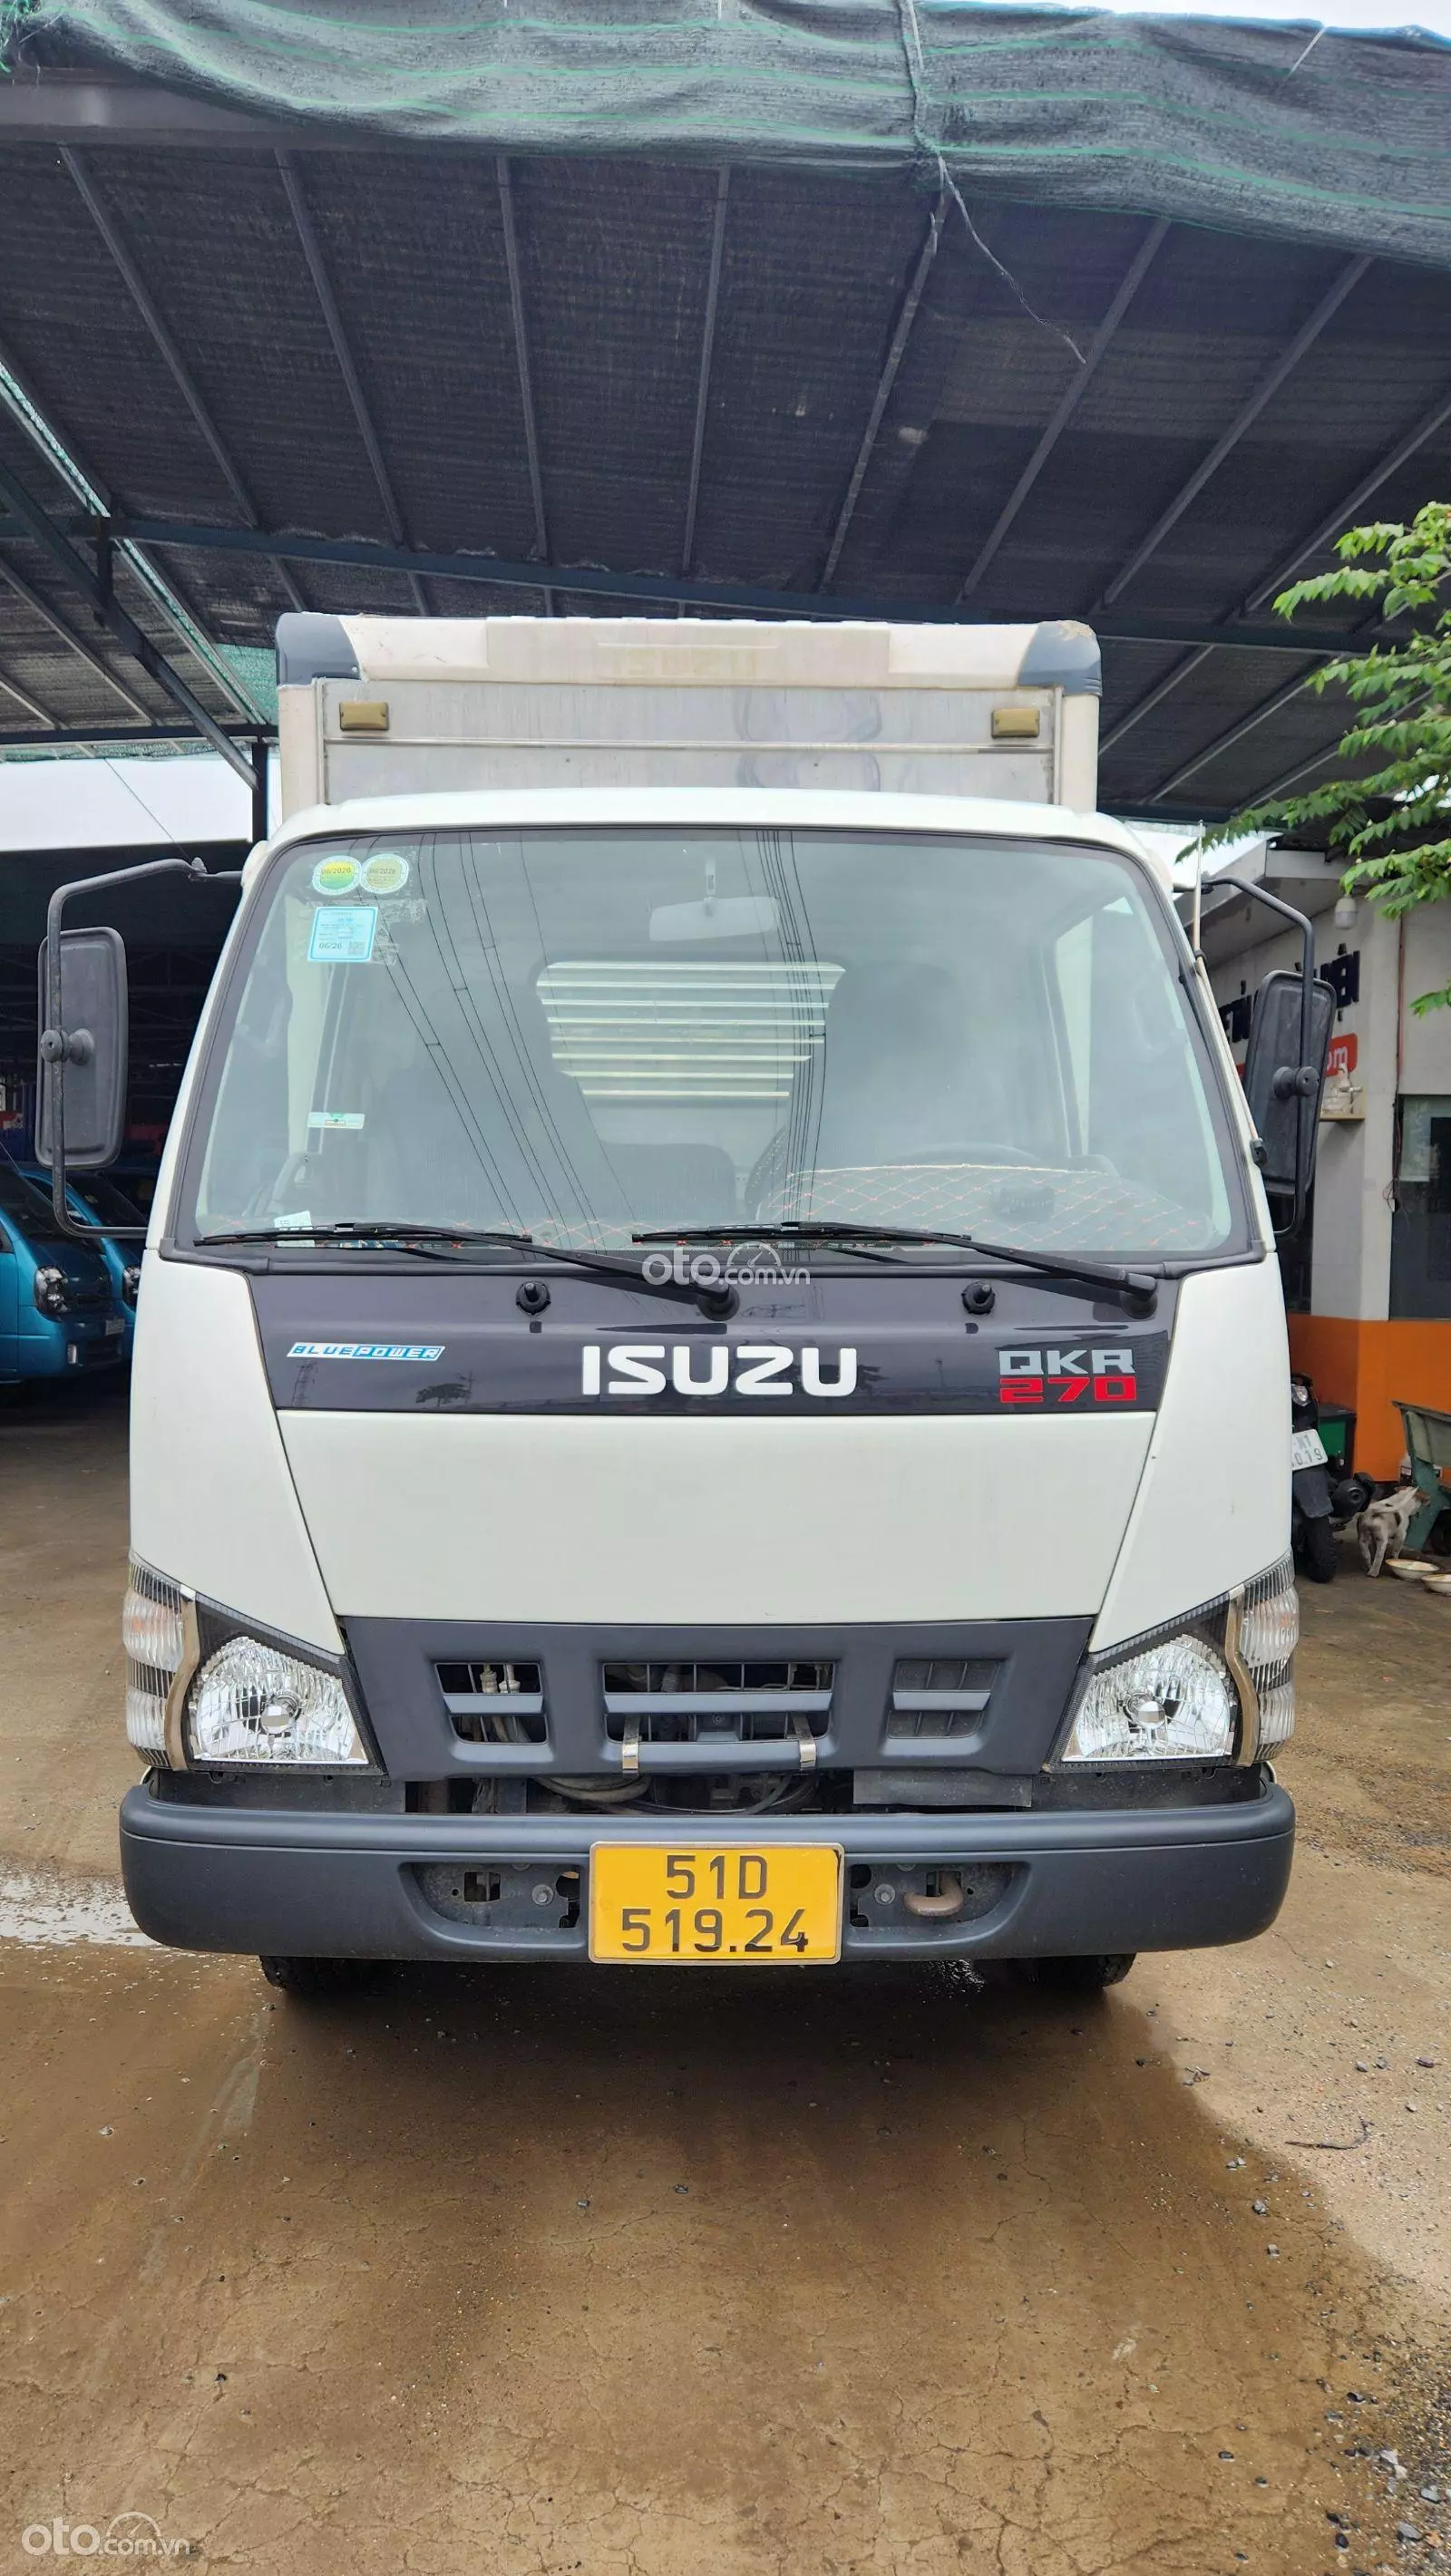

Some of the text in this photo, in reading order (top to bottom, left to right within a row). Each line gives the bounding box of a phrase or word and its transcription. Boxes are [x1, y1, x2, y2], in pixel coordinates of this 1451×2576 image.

[582, 1345, 857, 1396] ISUZU
[998, 1348, 1135, 1375] QKR
[999, 1375, 1137, 1404] 270
[666, 1854, 768, 1900] 51D
[621, 1908, 809, 1953] 519.24
